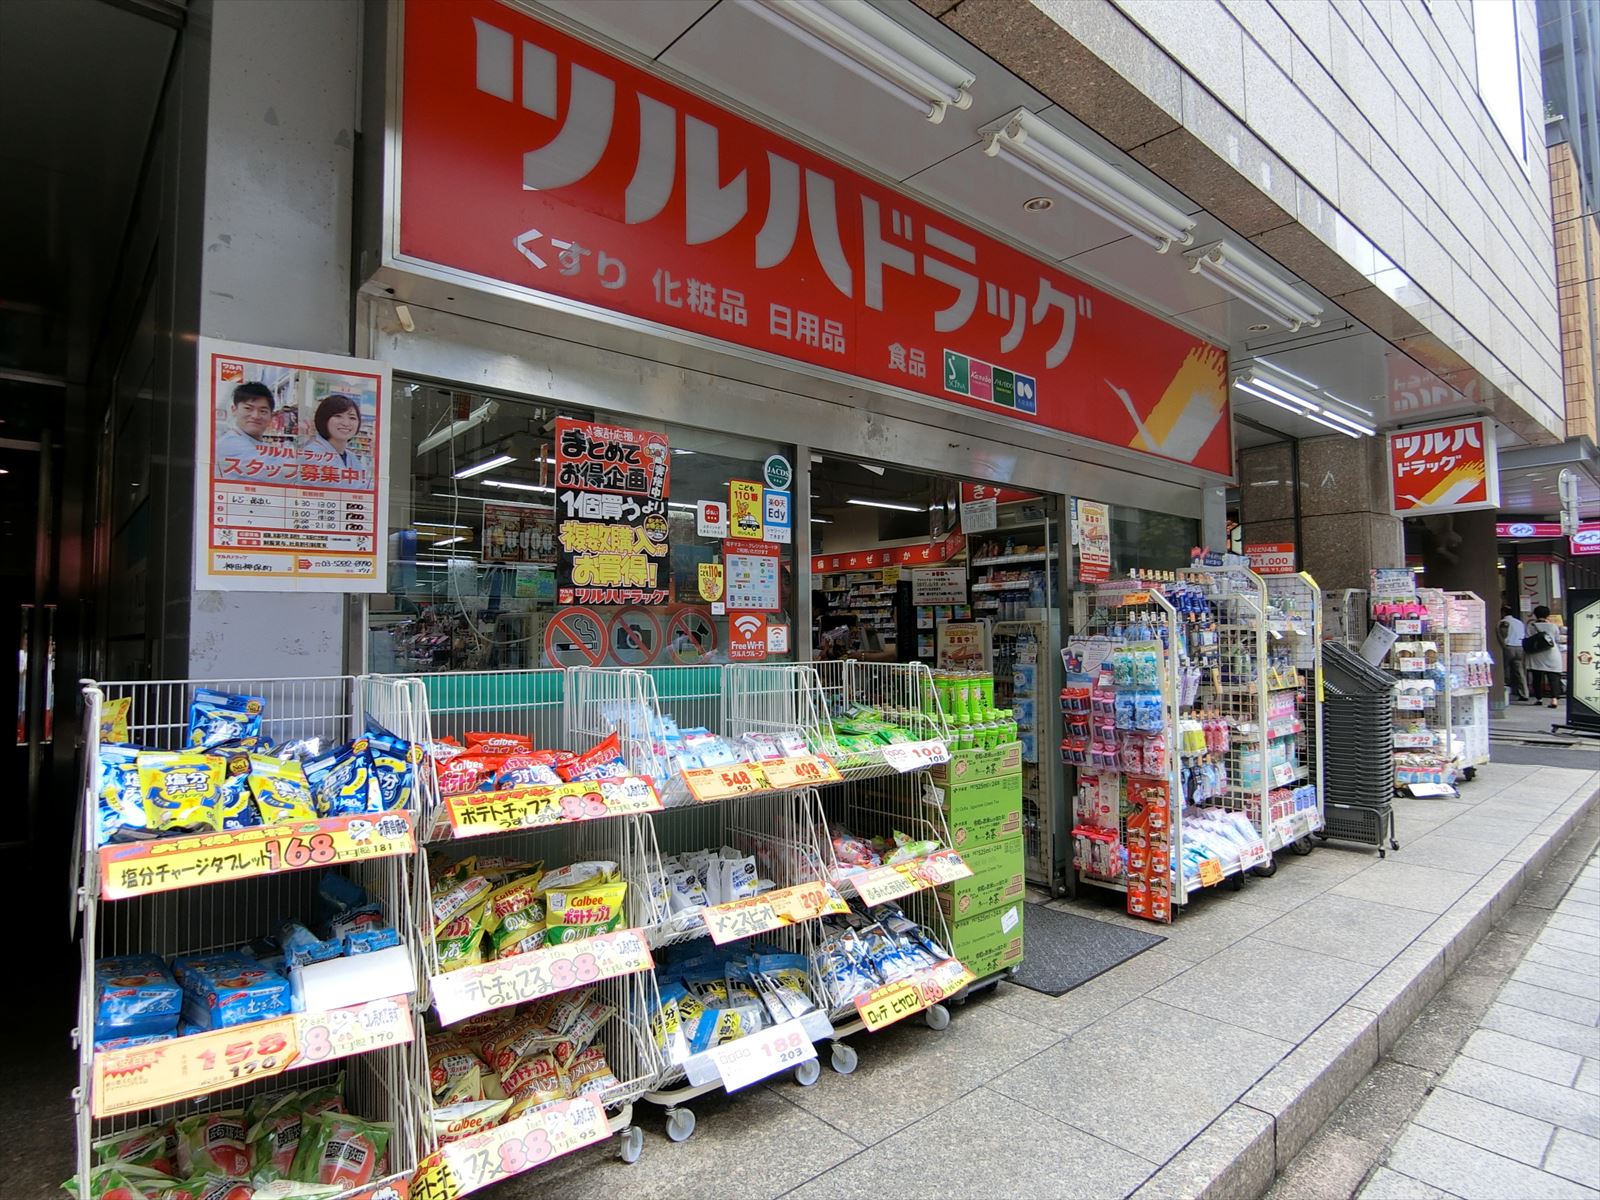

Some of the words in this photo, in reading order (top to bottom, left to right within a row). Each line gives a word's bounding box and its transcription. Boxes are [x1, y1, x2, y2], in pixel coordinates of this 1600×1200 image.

[472, 17, 1092, 368] ツルハドラッグ
[513, 229, 627, 290] くすり
[652, 269, 748, 328] 化粧品
[768, 303, 846, 355] 日用品
[888, 342, 927, 379] 食品
[255, 444, 334, 461] ツルハドラッグ
[561, 427, 642, 465] まとめて
[1395, 427, 1480, 459] ツルハ
[767, 466, 789, 477] JACDS
[1397, 455, 1462, 477] ドラッグ
[560, 461, 648, 492] お得企画
[768, 508, 786, 520] Edy
[575, 588, 670, 604] ツルハドラッグ
[488, 737, 518, 746] Calbee
[911, 746, 943, 758] 100
[928, 755, 946, 763] 108
[450, 761, 485, 774] Calbee
[794, 760, 820, 777] 498
[165, 772, 209, 786] 塩分
[721, 771, 751, 787] 548
[167, 785, 209, 795] チャージ
[460, 798, 553, 825] ポテトチップス
[558, 791, 609, 821] 88
[266, 833, 337, 870] 168
[373, 842, 393, 853] 181
[121, 848, 272, 889] 塩分チャージタブレット
[493, 884, 525, 901] Calbee
[571, 896, 604, 907] Calbee
[562, 907, 611, 925] ポテトチップス
[548, 952, 600, 989] 88
[464, 966, 547, 1002] テトチップス
[867, 1004, 889, 1025] ロッテ
[195, 1032, 288, 1071] 158
[760, 1031, 804, 1057] 188
[779, 1047, 804, 1063] 203
[447, 1117, 483, 1133] Calbee
[498, 1127, 552, 1173] 88
